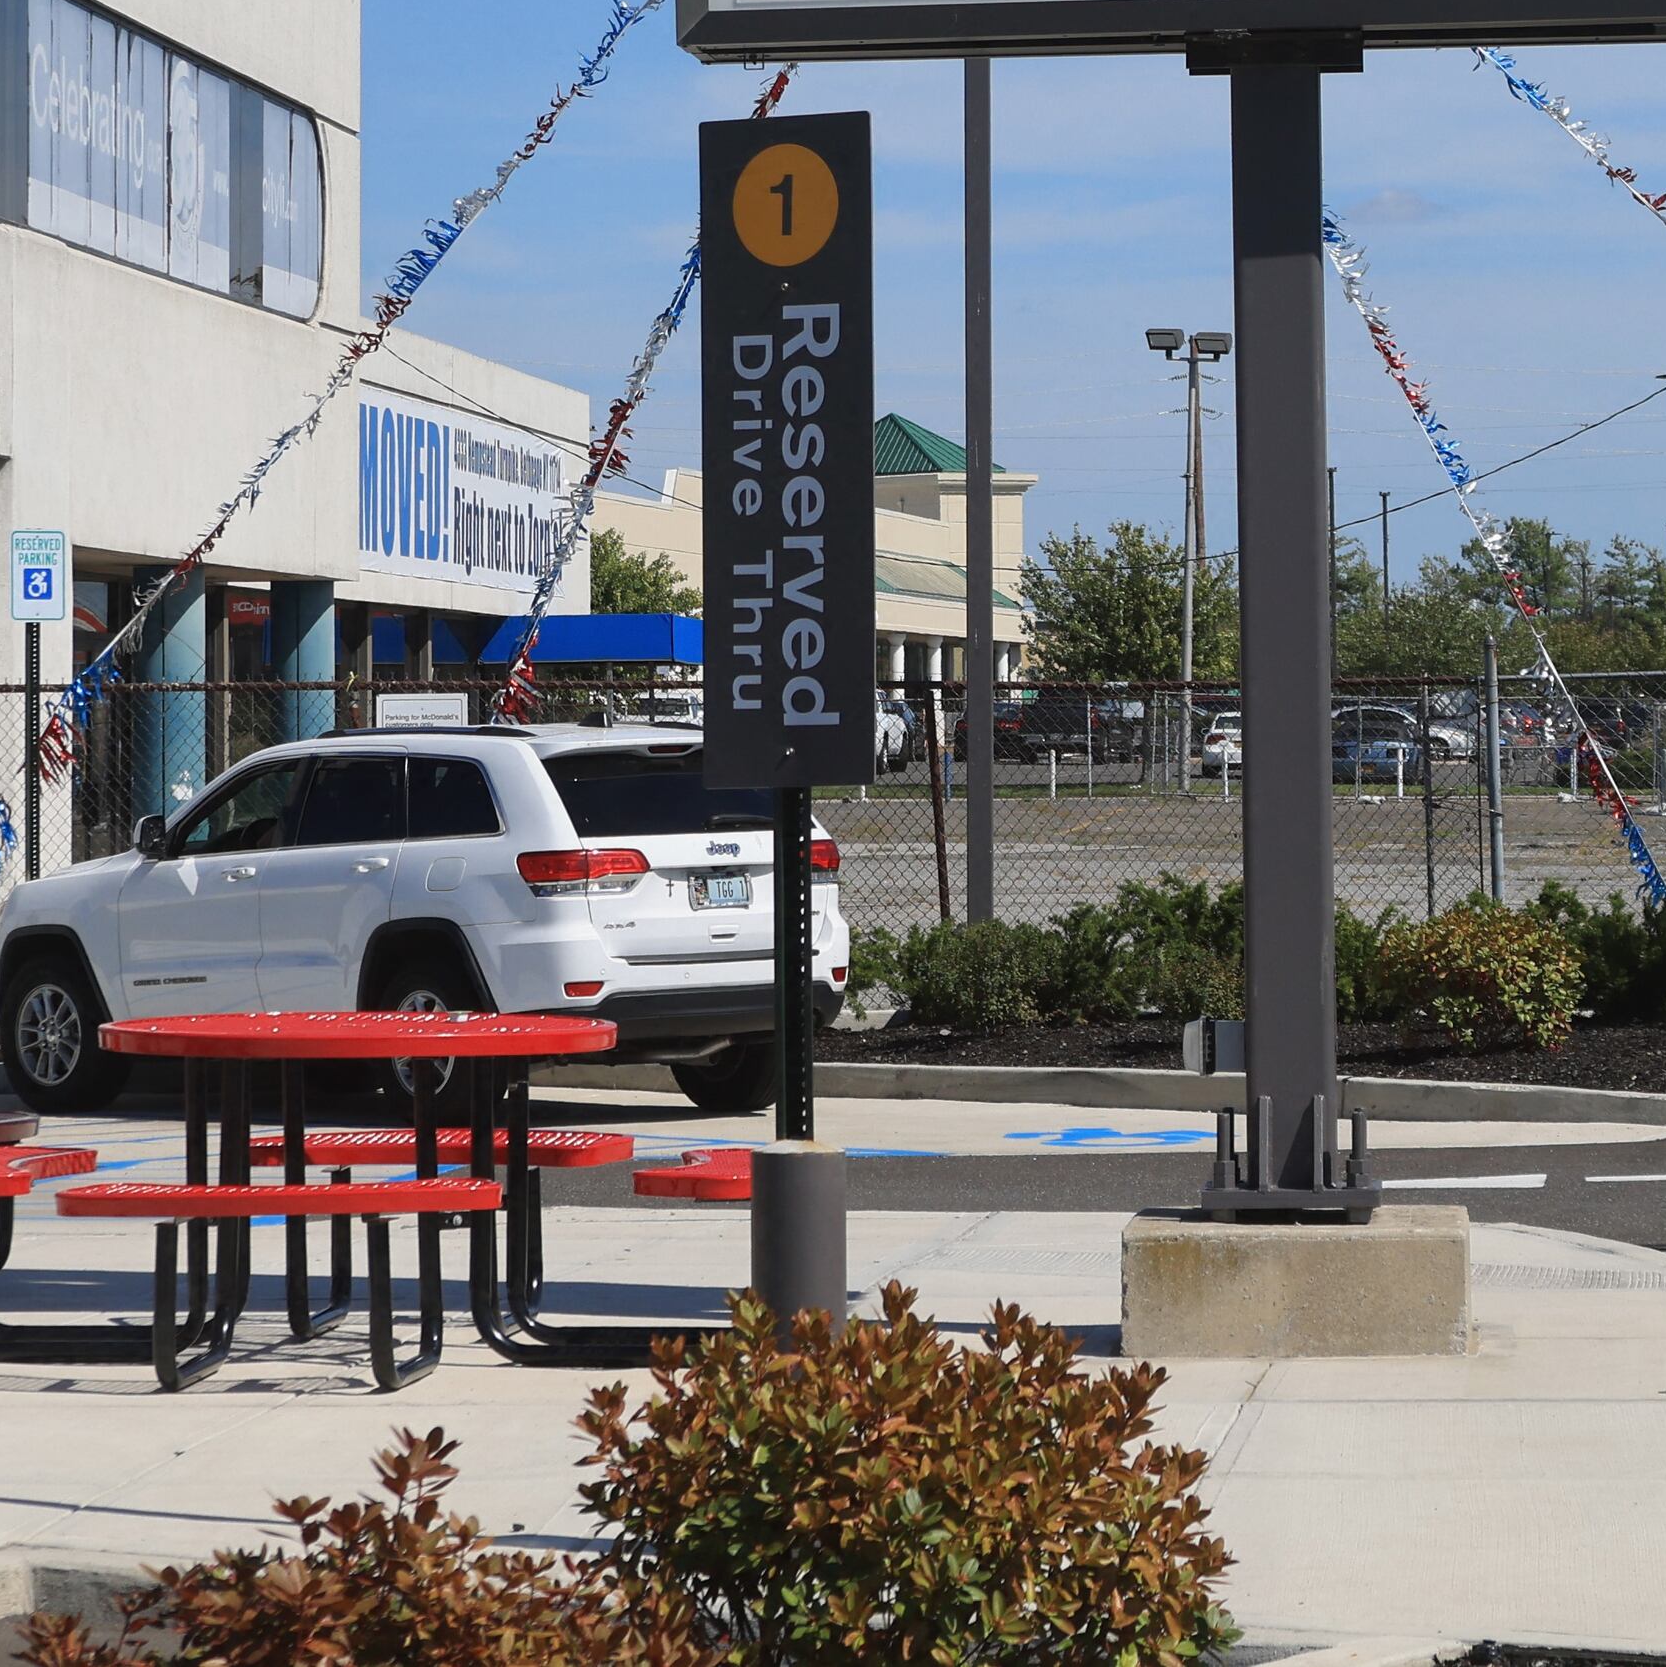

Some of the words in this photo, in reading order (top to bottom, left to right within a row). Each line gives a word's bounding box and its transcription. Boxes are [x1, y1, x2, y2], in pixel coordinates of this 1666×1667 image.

[30, 42, 145, 189] Celebrating
[769, 174, 793, 236] 1
[733, 335, 773, 517] Drive
[359, 403, 450, 563] MOVED!
[782, 304, 840, 727] Reserved
[14, 538, 61, 551] RESERVED
[18, 552, 58, 566] PARKING
[453, 486, 485, 576] Right
[487, 504, 512, 573] next
[514, 505, 525, 575] to
[733, 550, 774, 711] Thru
[385, 714, 410, 722] Parking
[421, 713, 459, 721] McDonald's
[705, 840, 741, 857] Jeep
[716, 881, 734, 899] TGG
